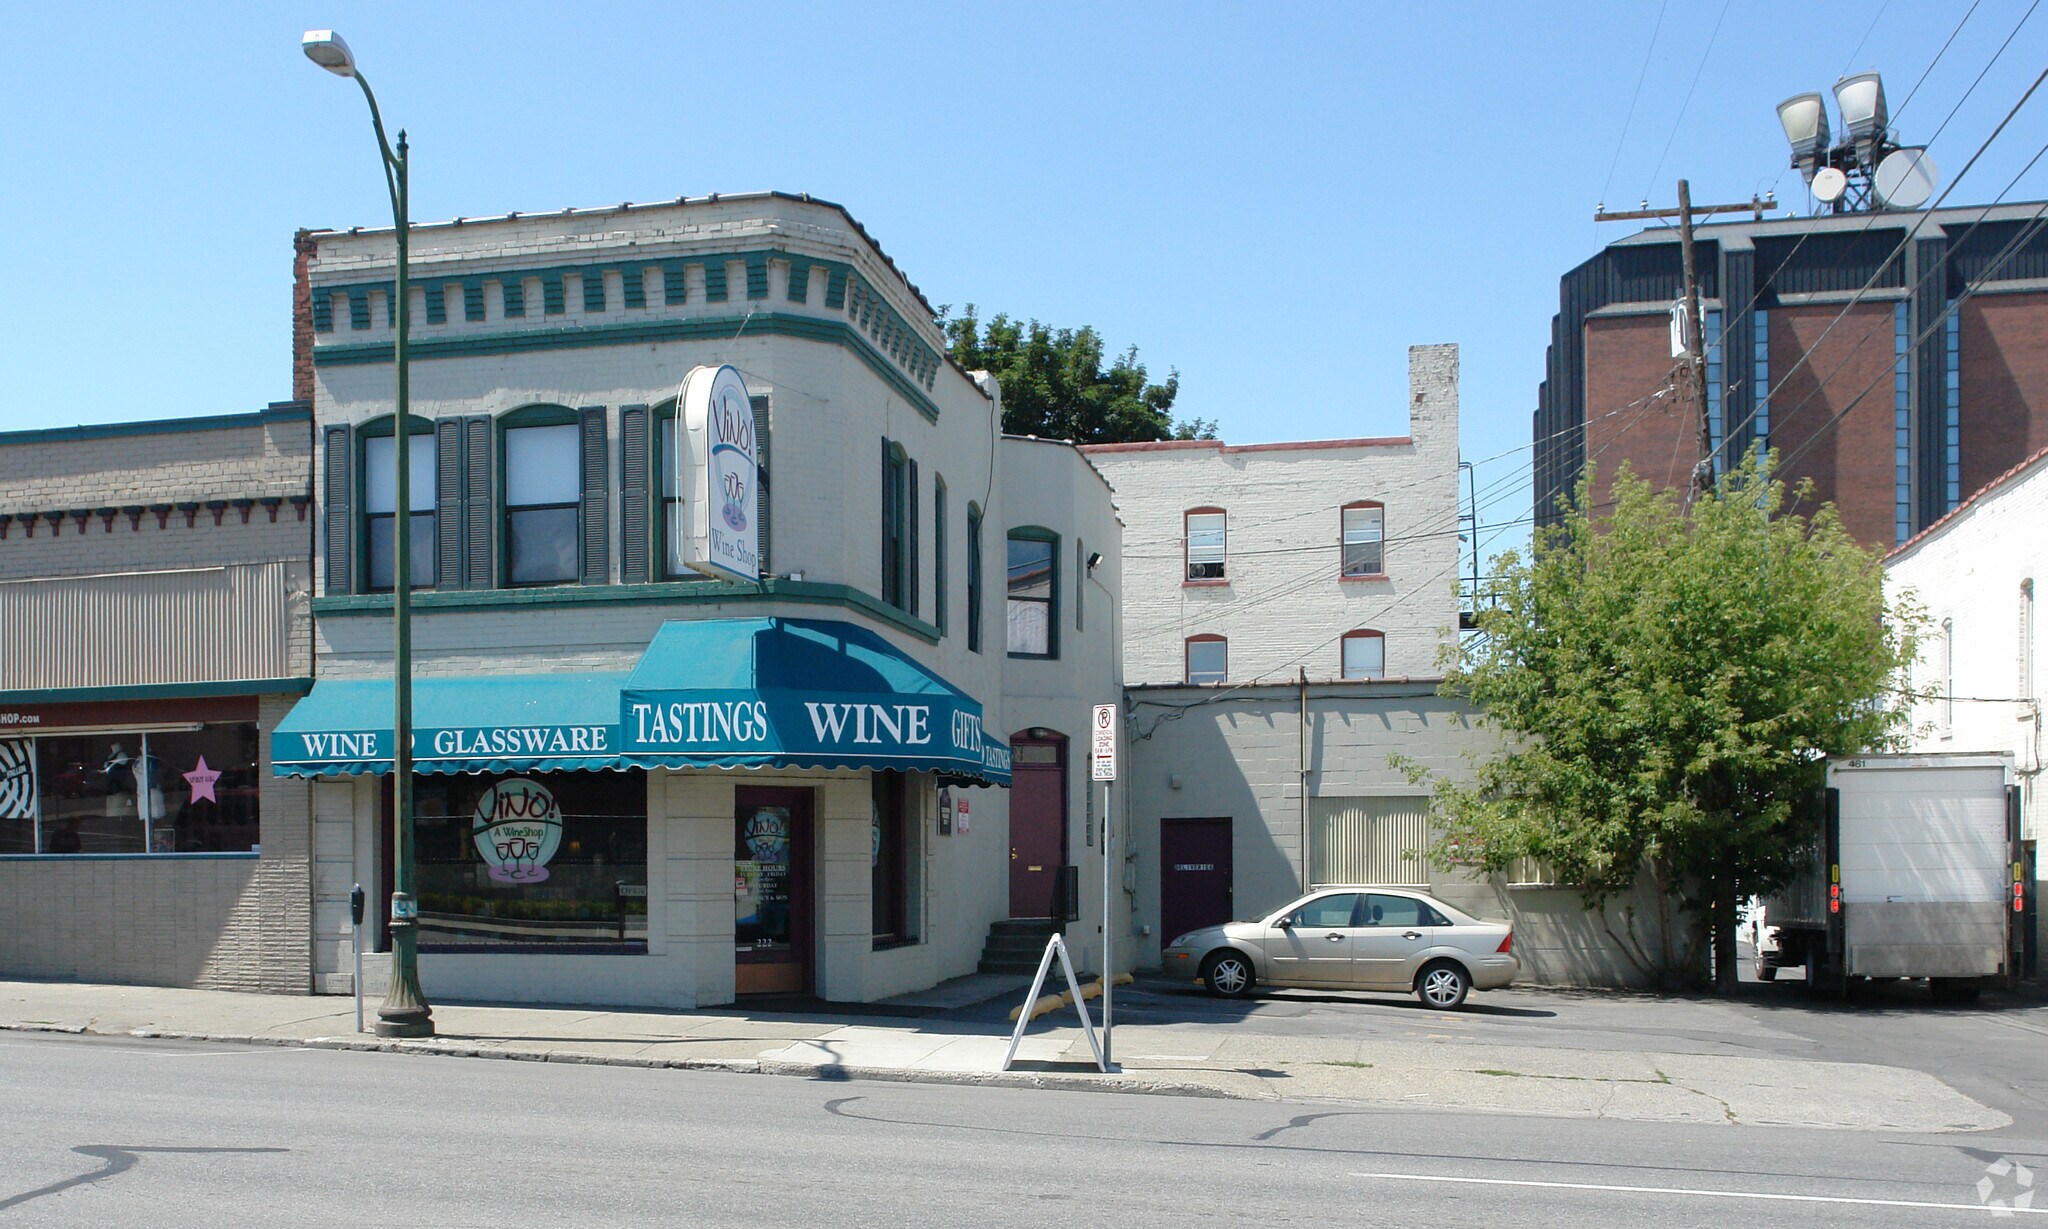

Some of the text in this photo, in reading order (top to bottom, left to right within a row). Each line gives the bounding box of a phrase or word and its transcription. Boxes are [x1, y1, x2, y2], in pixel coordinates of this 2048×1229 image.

[712, 527, 756, 573] Wine Shop
[632, 700, 767, 743] TASTINGS
[804, 702, 931, 744] WINE
[951, 709, 981, 753] GIFTS
[302, 732, 378, 757] WINE
[434, 727, 608, 755] GLASSWARE
[985, 745, 1011, 770] TASTINGS
[494, 827, 501, 837] A
[756, 938, 773, 948] 222
